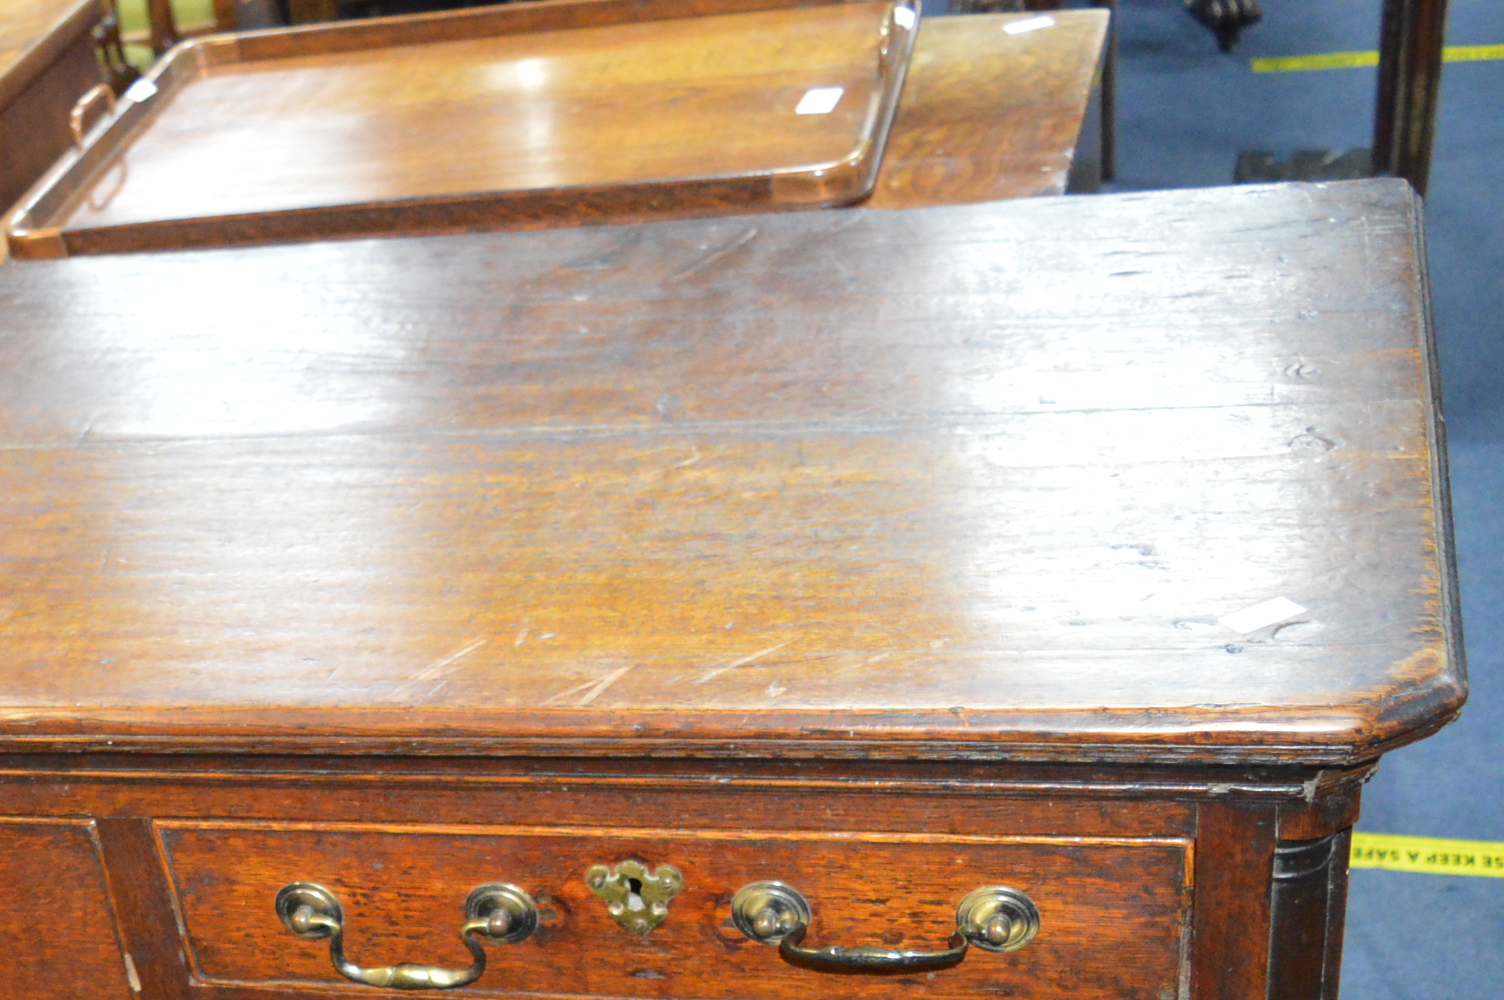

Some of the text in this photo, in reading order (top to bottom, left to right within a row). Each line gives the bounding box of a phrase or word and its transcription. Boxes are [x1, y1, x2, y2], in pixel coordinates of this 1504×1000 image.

[1353, 848, 1400, 861] SAFE
[1407, 850, 1420, 862] A
[1426, 853, 1475, 867] KEEP
